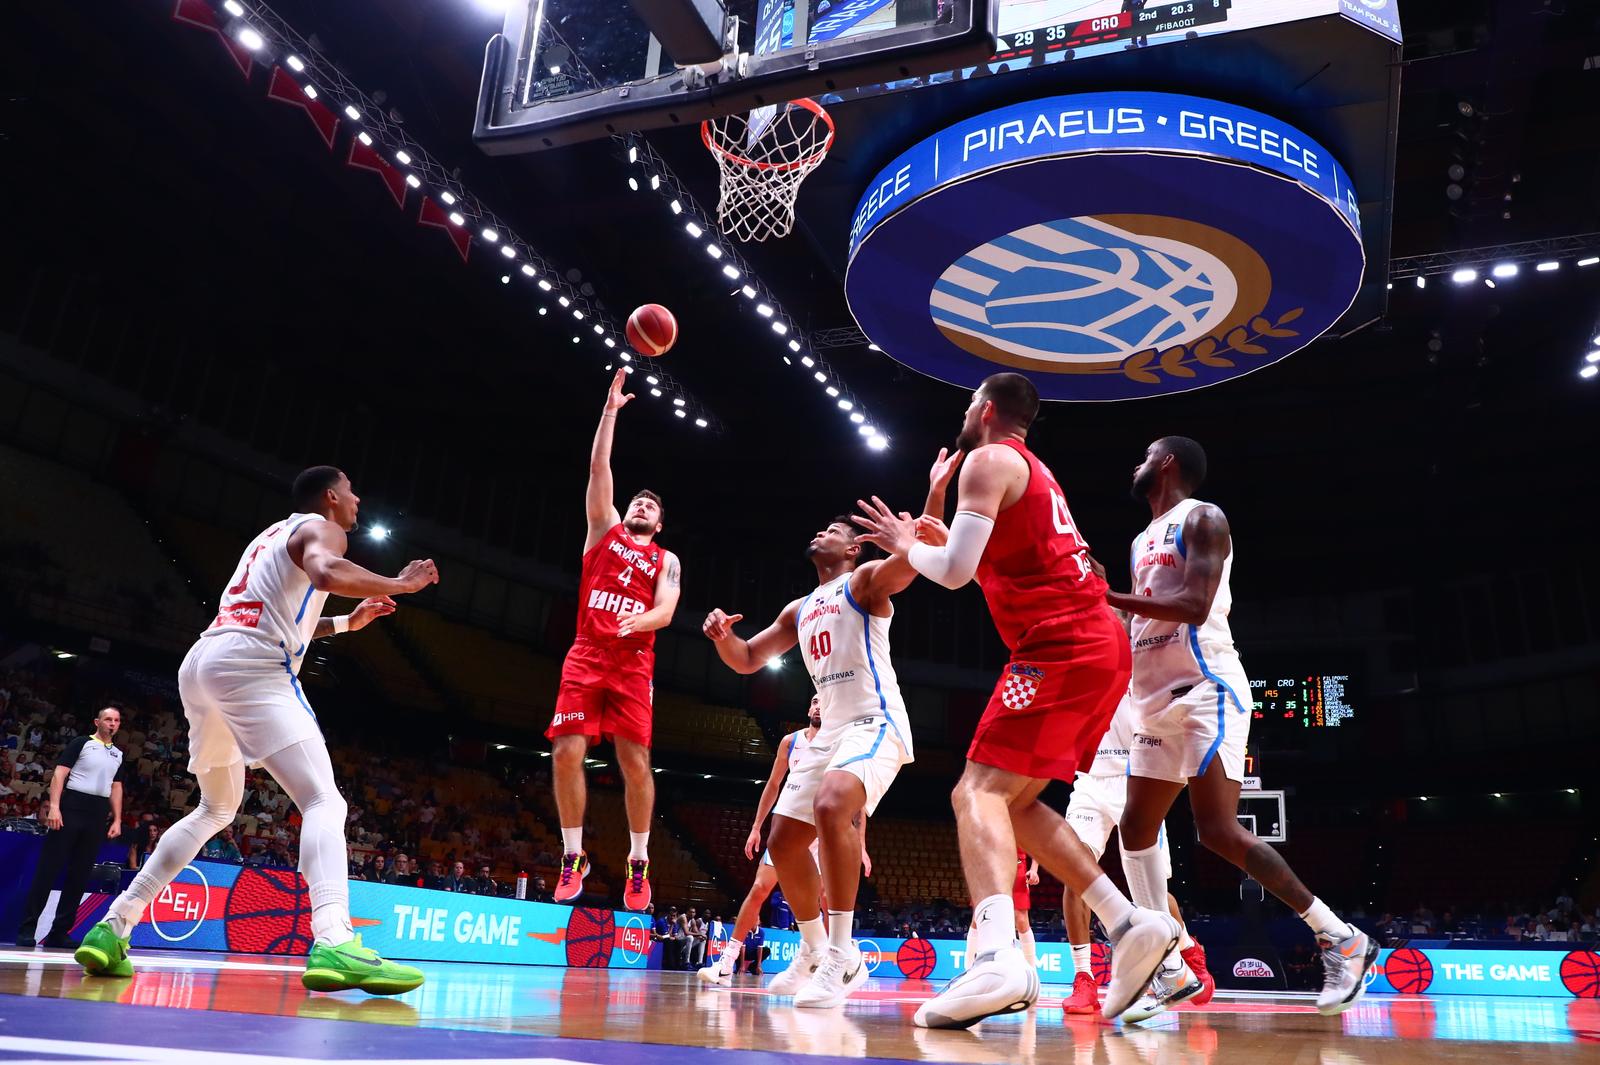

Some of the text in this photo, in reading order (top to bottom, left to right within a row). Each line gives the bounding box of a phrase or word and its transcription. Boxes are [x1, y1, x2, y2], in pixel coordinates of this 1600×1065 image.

[1139, 3, 1193, 22] 2nd 20.3
[1343, 2, 1364, 15] TEAM
[1091, 15, 1119, 32] CRO
[1014, 25, 1066, 47] 29 35
[963, 107, 1320, 179] PIRAEUS GREECE
[608, 540, 657, 579] HRVATSKA
[617, 565, 634, 587] 4
[810, 630, 831, 661] 40
[1250, 679, 1294, 688] DOM CRO
[1285, 701, 1296, 709] 35
[562, 712, 585, 722] HPB
[393, 904, 522, 947] THE GAME
[1441, 963, 1551, 981] THE GAME
